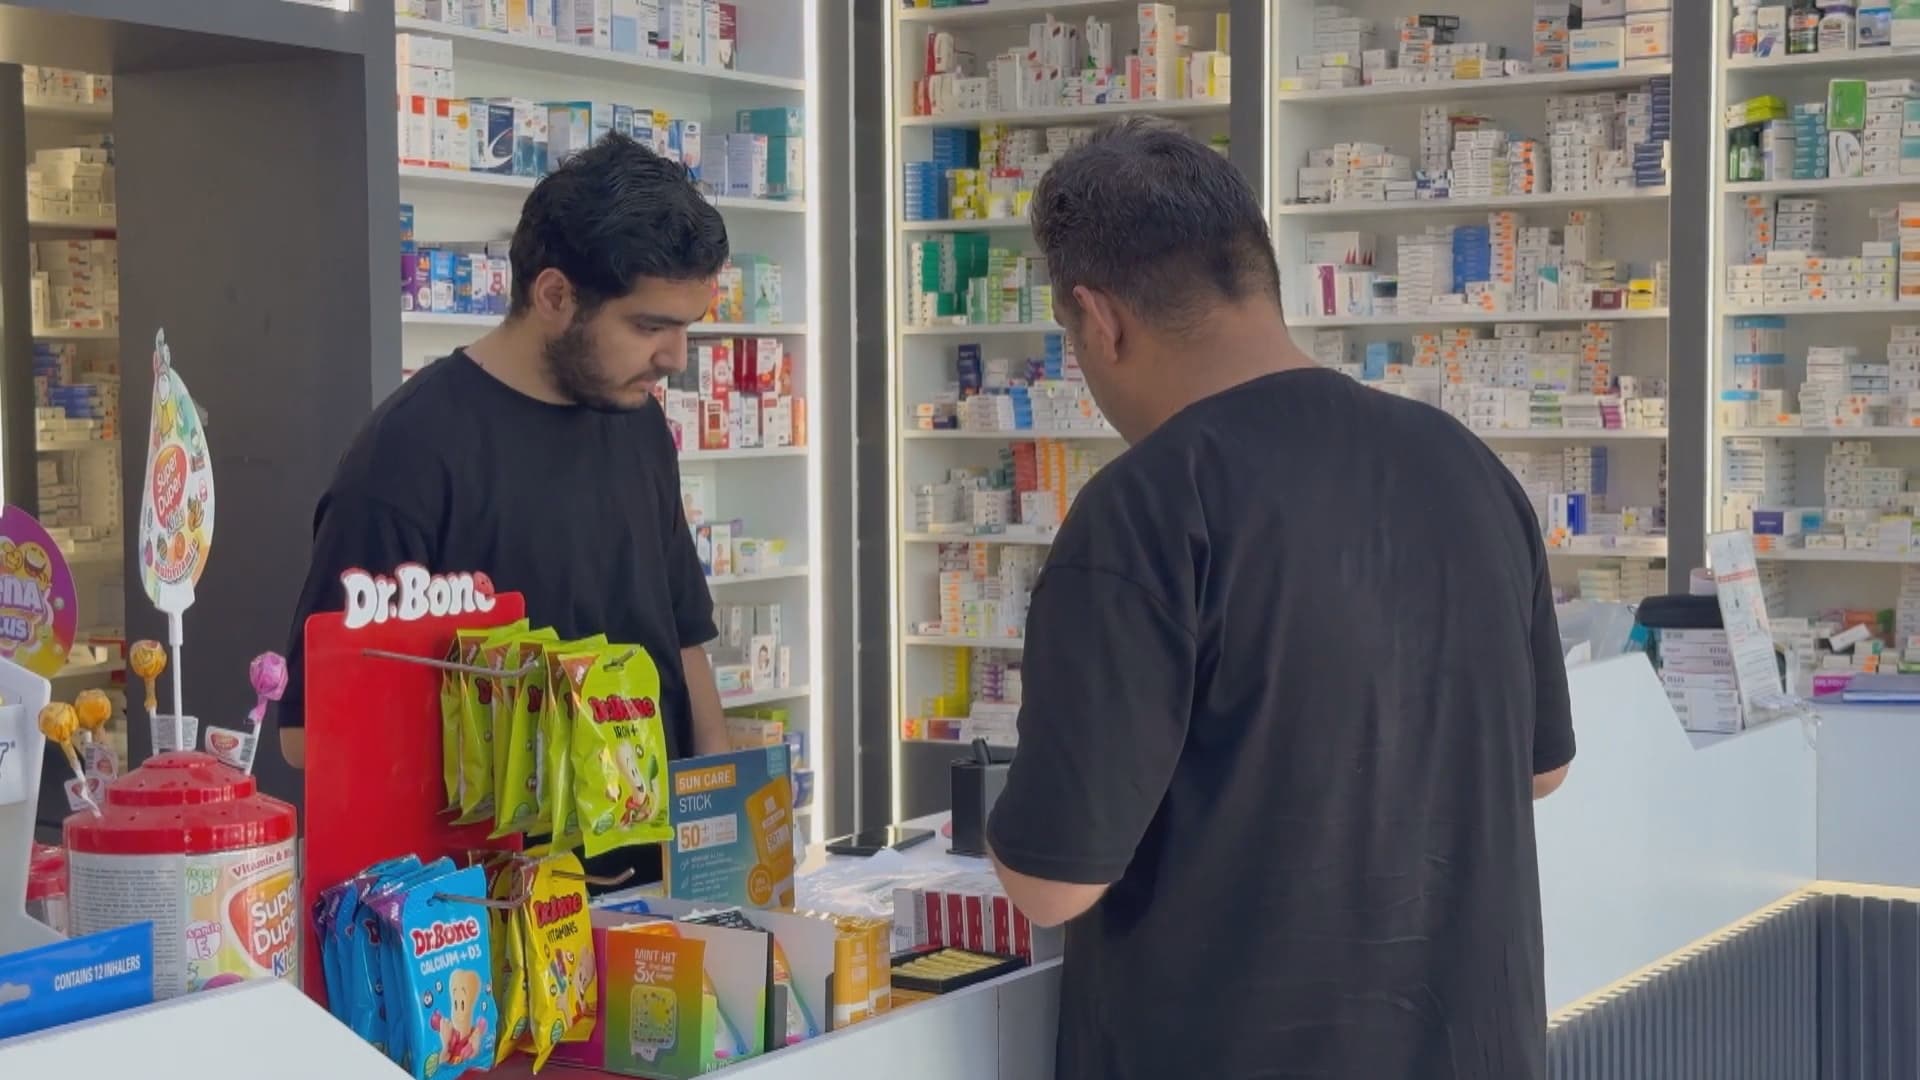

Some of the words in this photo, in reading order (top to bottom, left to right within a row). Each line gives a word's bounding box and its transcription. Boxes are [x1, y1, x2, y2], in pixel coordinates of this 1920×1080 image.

[341, 563, 495, 629] Dr.Bone
[679, 775, 701, 791] SUN
[704, 769, 732, 787] CARE
[680, 793, 712, 813] STICK
[232, 856, 275, 877] Vitamin
[251, 882, 297, 928] Supe
[410, 917, 480, 958] Dr.Bone
[546, 920, 578, 943] VITAMINS
[421, 951, 460, 975] CALCIUM
[467, 944, 481, 959] D3
[634, 949, 660, 962] MINT
[660, 951, 676, 965] HIT
[54, 966, 93, 992] CONTAINS
[94, 963, 104, 980] 12
[104, 954, 141, 977] INHALERS
